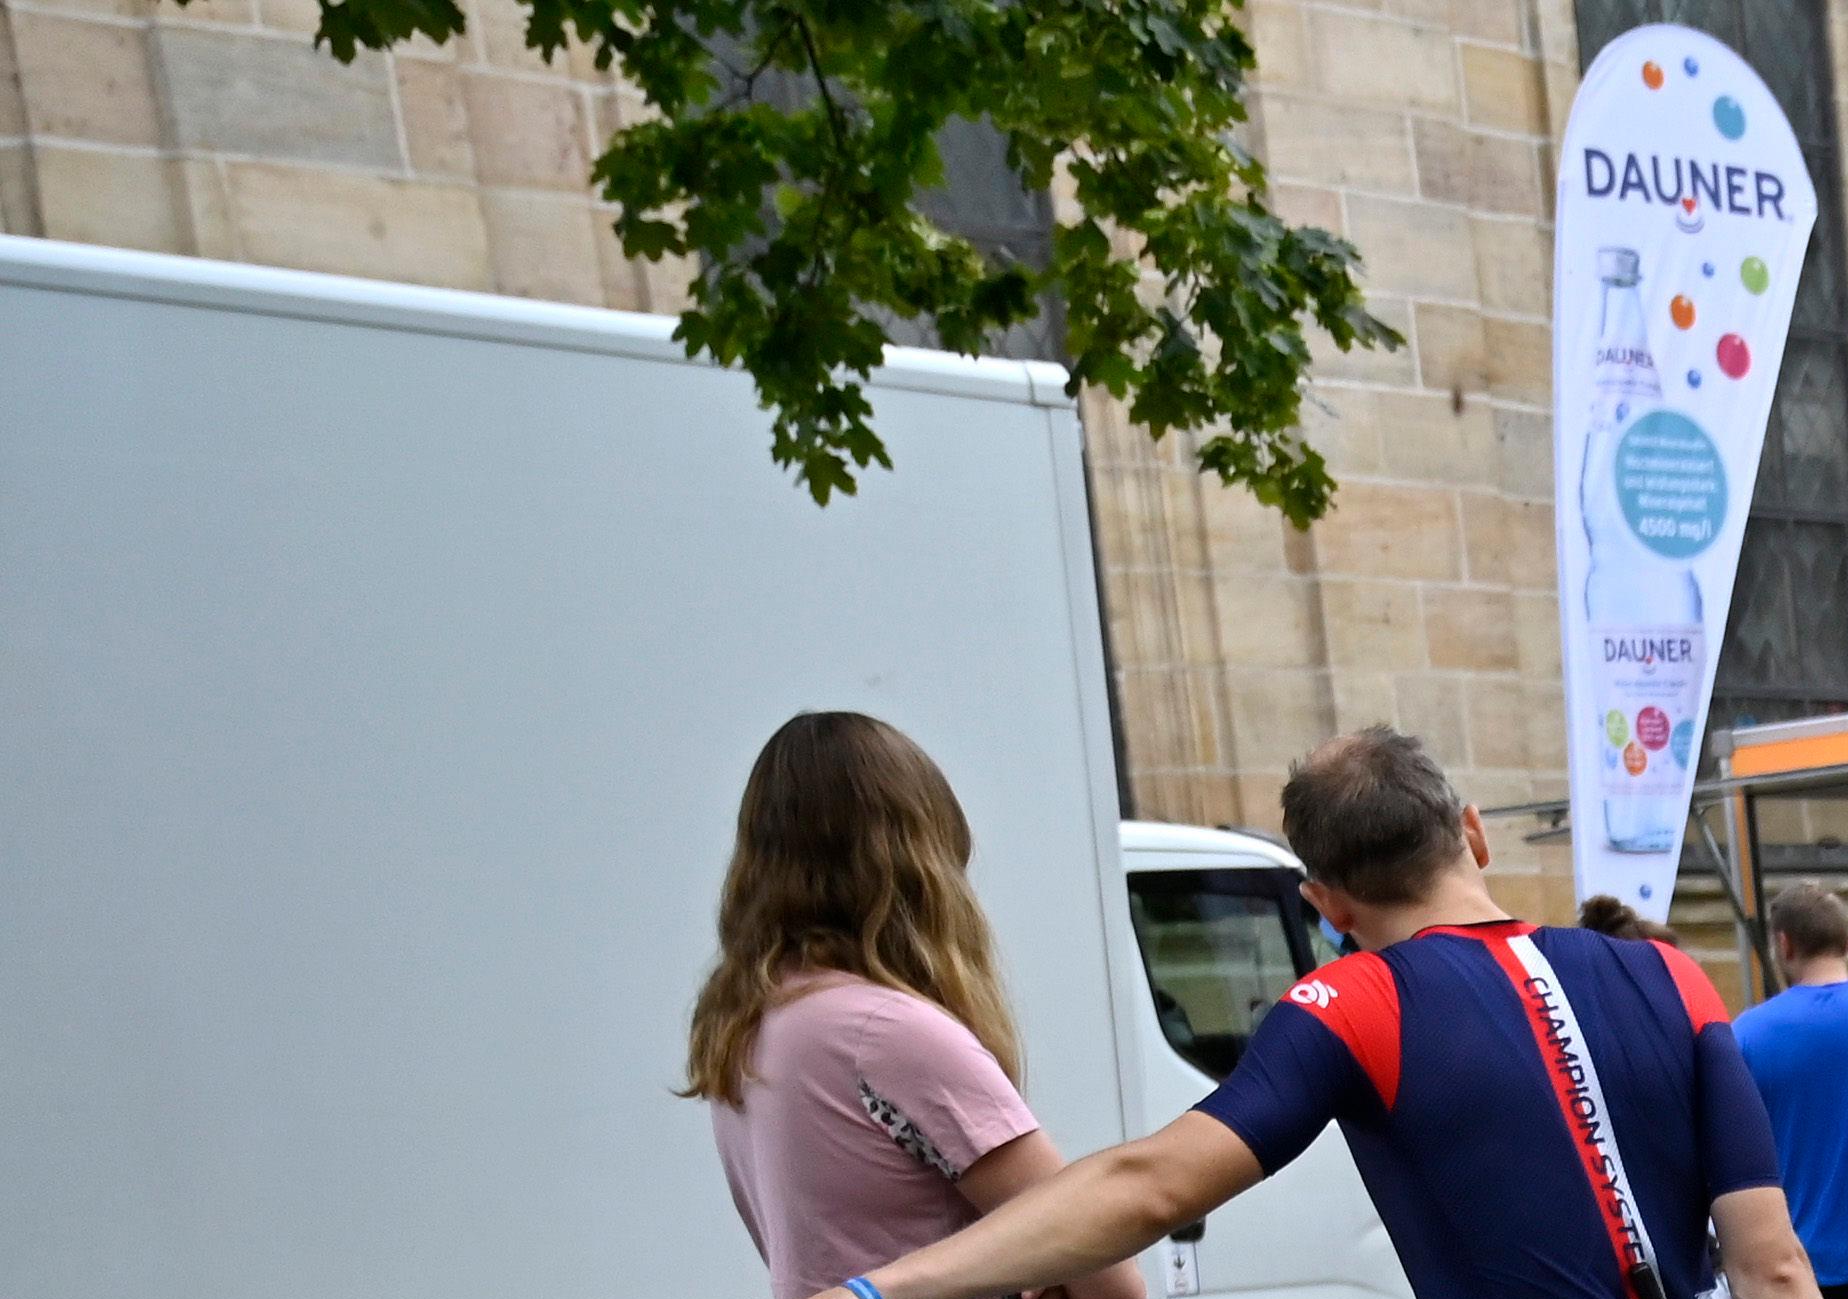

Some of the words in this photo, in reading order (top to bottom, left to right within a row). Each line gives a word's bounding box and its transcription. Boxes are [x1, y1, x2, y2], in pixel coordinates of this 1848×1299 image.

[1583, 147, 1786, 221] DAUNER
[1603, 637, 1693, 663] DAUNER
[1524, 976, 1605, 1148] CHAMPION
